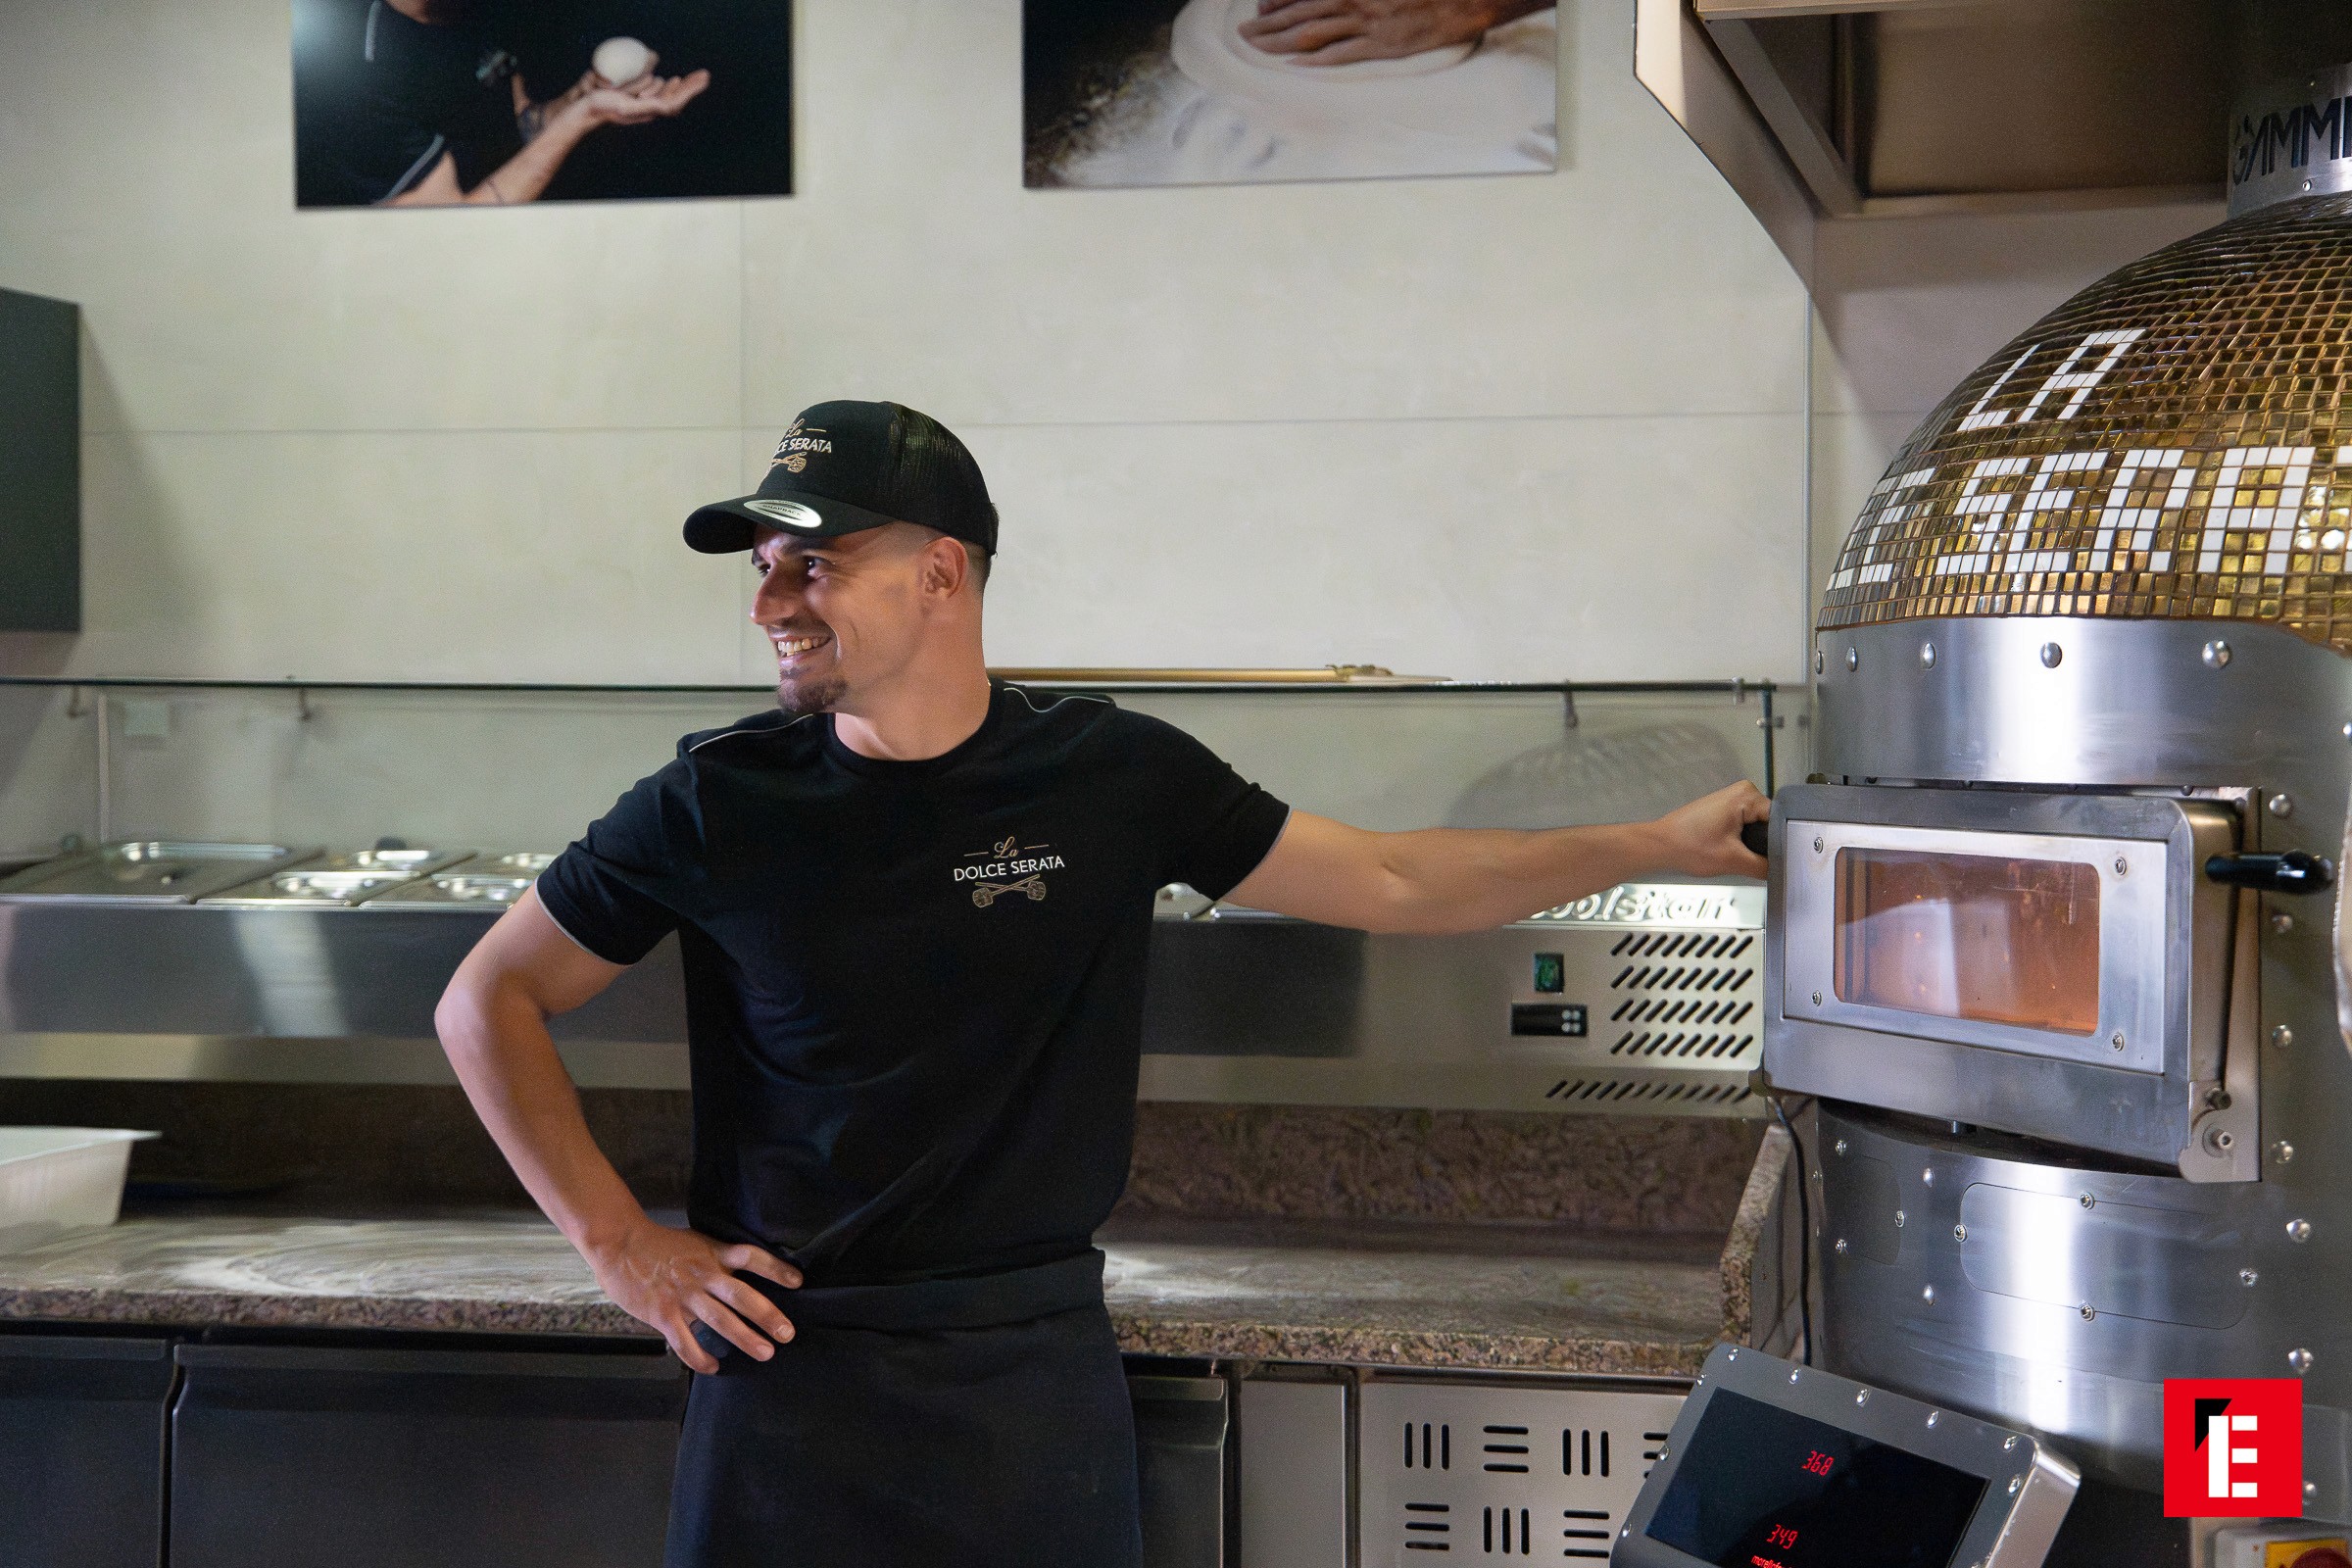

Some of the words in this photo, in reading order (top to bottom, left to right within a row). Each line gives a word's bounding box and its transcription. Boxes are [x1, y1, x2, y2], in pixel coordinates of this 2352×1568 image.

[1957, 328, 2147, 433] LA
[788, 438, 832, 453] SERATA
[1936, 446, 2352, 576] SERA
[993, 836, 1019, 858] La
[954, 862, 1006, 881] DOLCE
[1010, 856, 1065, 874] SERATA
[1801, 1450, 1835, 1477] 368
[1766, 1524, 1798, 1549] 349
